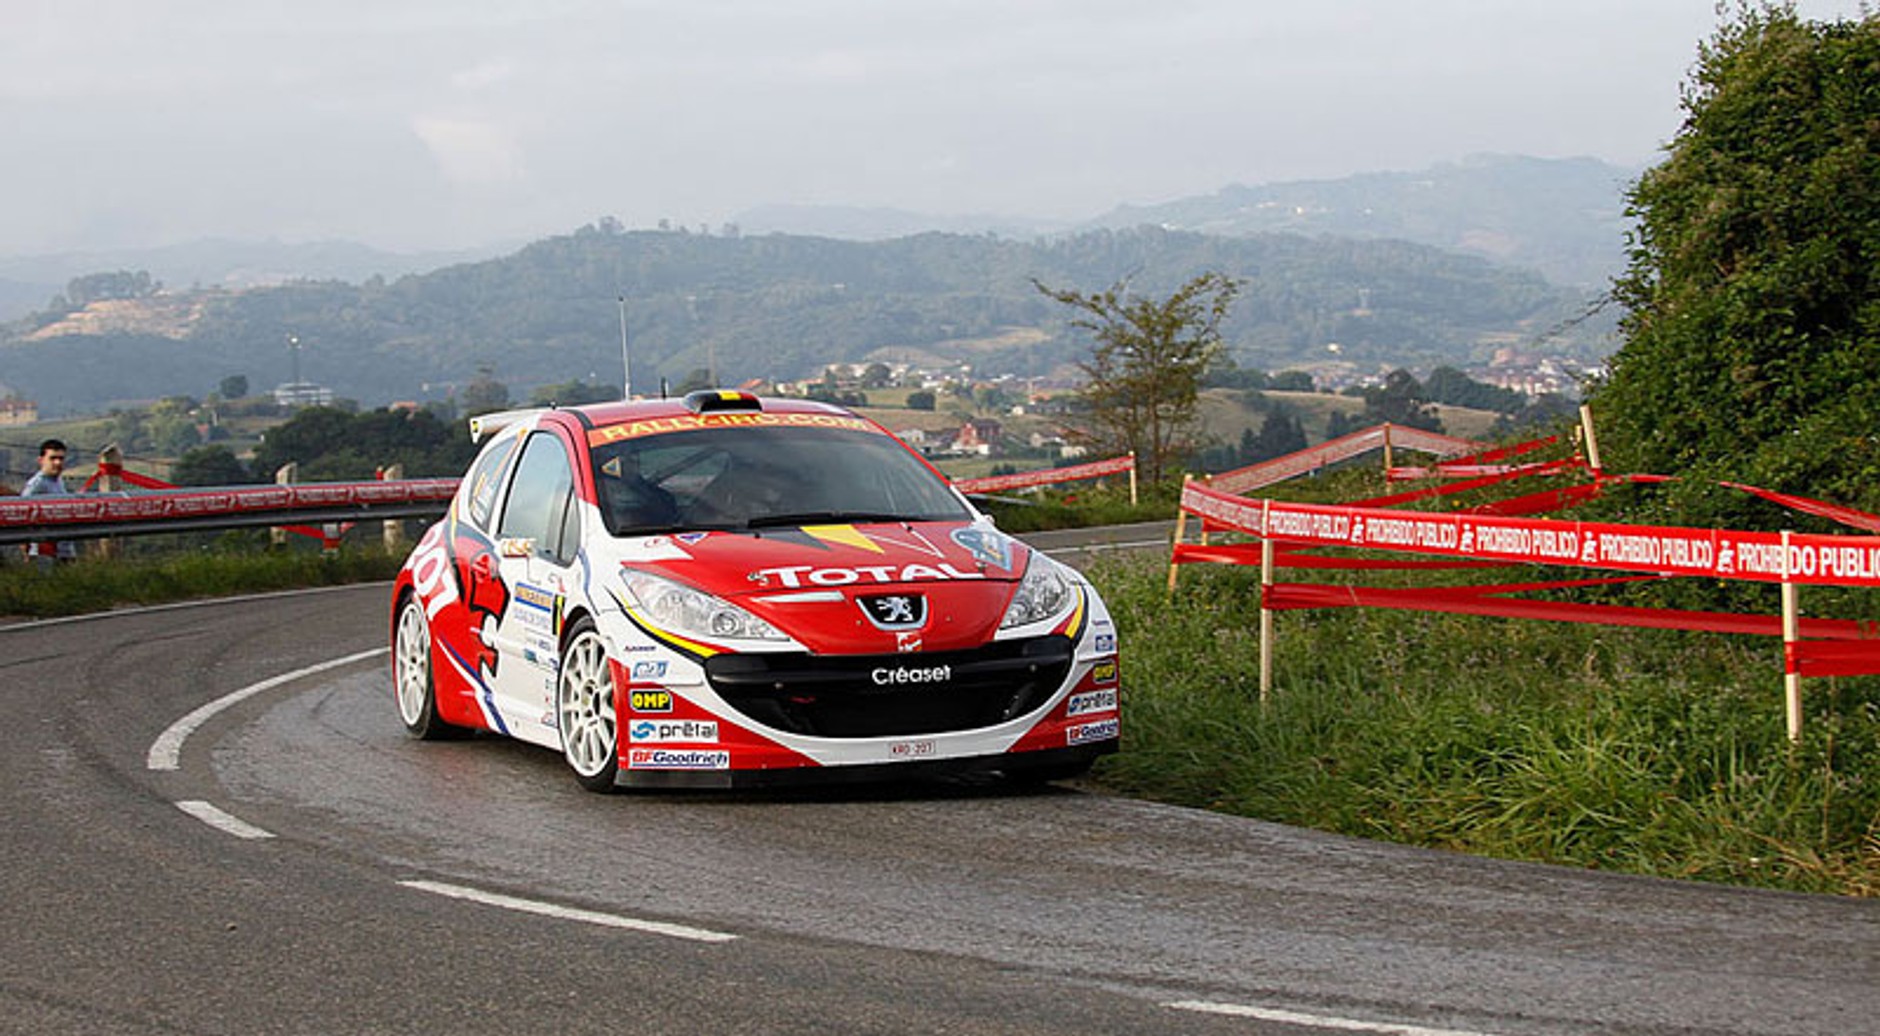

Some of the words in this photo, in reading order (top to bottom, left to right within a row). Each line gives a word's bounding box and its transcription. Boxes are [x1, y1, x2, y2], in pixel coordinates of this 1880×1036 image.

[1366, 518, 1414, 545] PROHIBIDO
[1416, 522, 1457, 549] PUBLICO
[1476, 525, 1531, 554] PROHIBIDO
[1532, 529, 1578, 559] PUBLICO
[1599, 534, 1660, 564] PROHIBIDO
[1661, 537, 1712, 568] PUBLICO
[1737, 542, 1817, 576] PROHIBDO
[759, 563, 986, 588] TOTAL
[872, 664, 951, 685] Créaset
[632, 693, 669, 708] OMP
